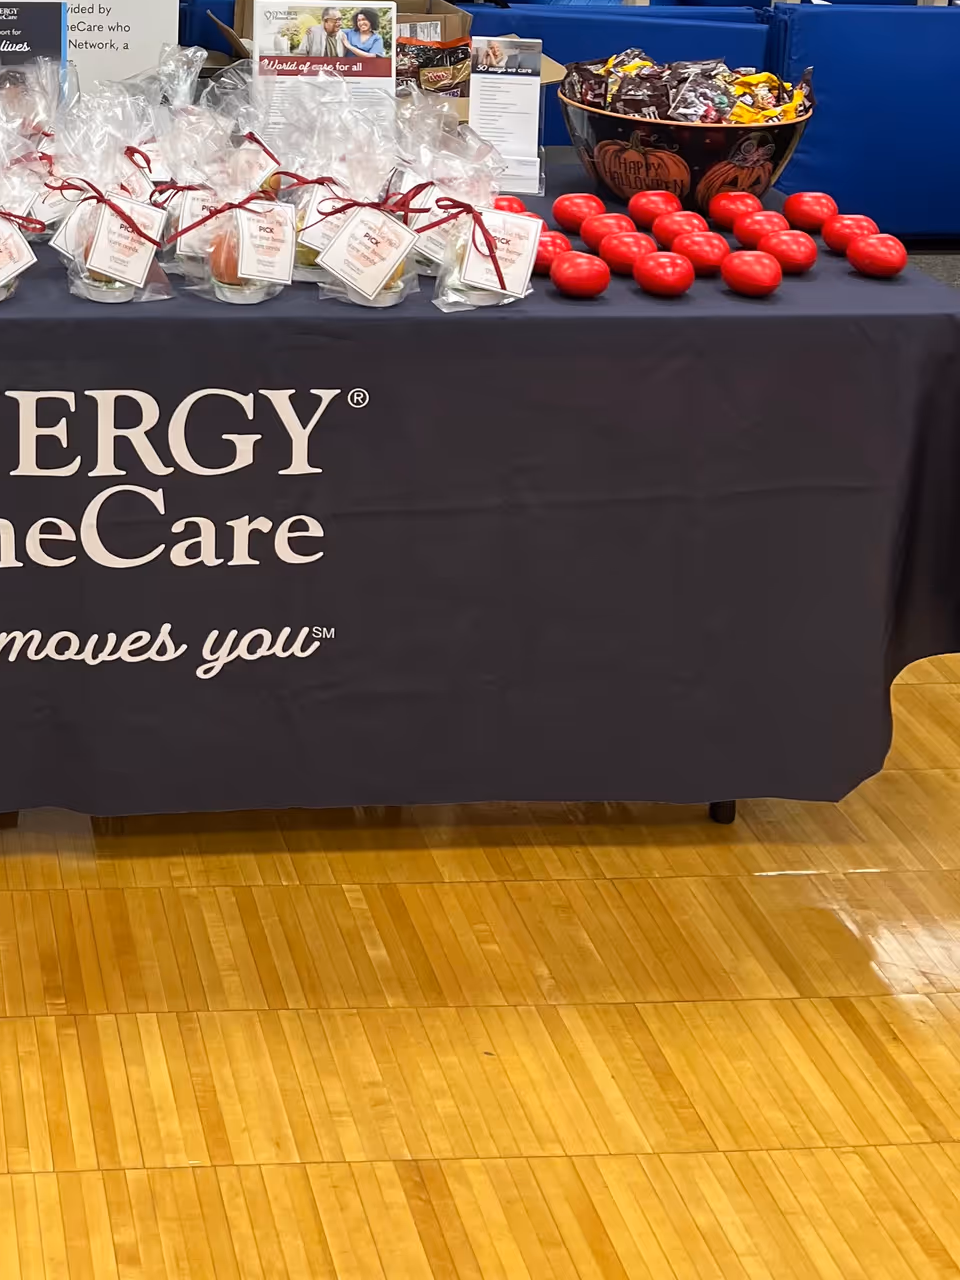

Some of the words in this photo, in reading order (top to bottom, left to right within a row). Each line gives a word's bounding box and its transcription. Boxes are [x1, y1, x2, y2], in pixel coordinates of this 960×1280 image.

[98, 3, 112, 16] by
[107, 22, 131, 32] who
[68, 39, 119, 51] Network,
[260, 58, 297, 71] World
[299, 61, 312, 73] of
[336, 62, 350, 71] for
[351, 62, 363, 71] all
[619, 157, 661, 177] HAPPY
[258, 225, 275, 234] PICK
[363, 232, 381, 247] PICK
